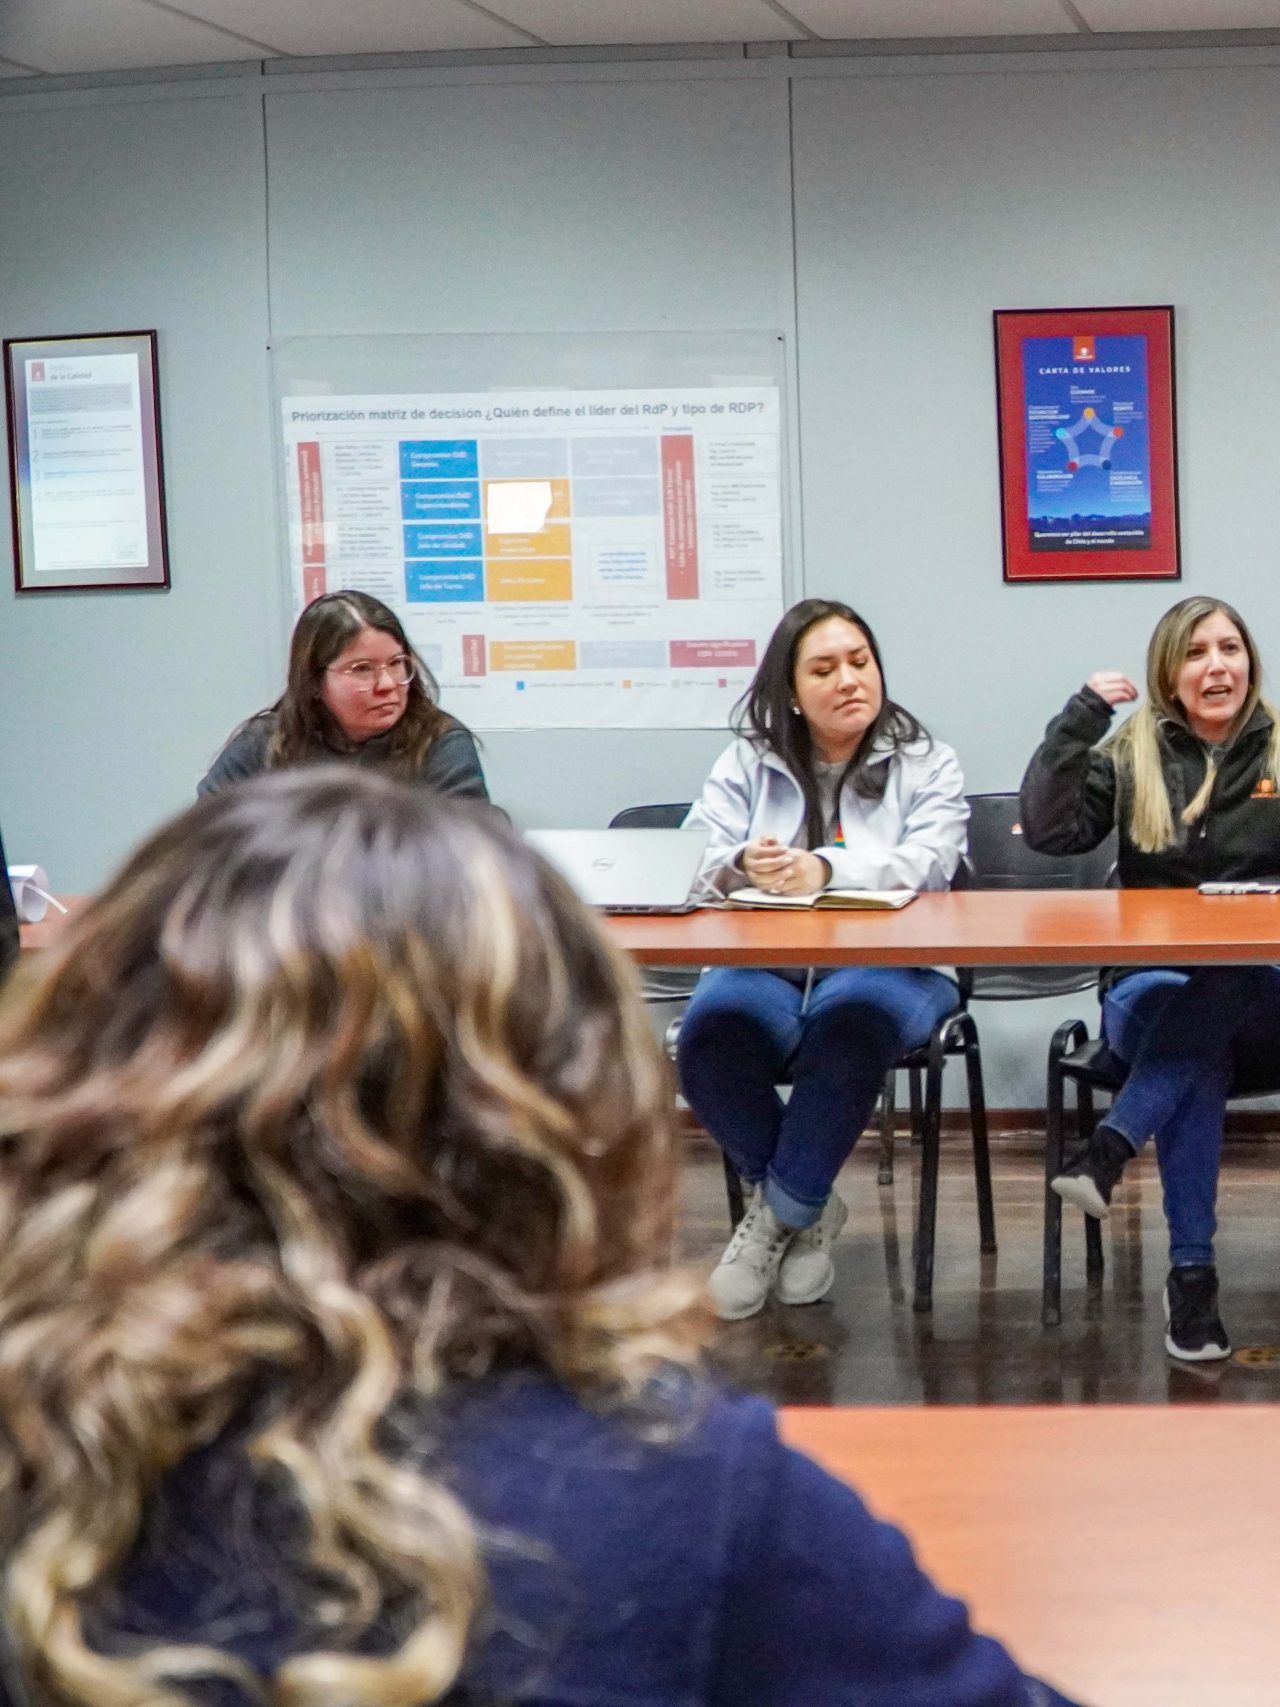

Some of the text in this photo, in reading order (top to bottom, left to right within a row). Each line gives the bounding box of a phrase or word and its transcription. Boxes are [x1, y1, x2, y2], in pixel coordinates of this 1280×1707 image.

[1039, 365, 1131, 376] CARTA DE VALORES
[291, 409, 364, 423] Priorización
[368, 408, 406, 421] matriz
[411, 408, 425, 420] de
[429, 406, 482, 420] decisión
[485, 405, 530, 421] ¿Quién
[533, 404, 572, 418] define
[574, 404, 586, 417] el
[620, 403, 639, 416] del
[642, 402, 668, 415] RdP
[671, 405, 679, 417] y
[682, 402, 706, 416] tipo
[710, 402, 725, 414] de
[729, 402, 764, 414] RDP?
